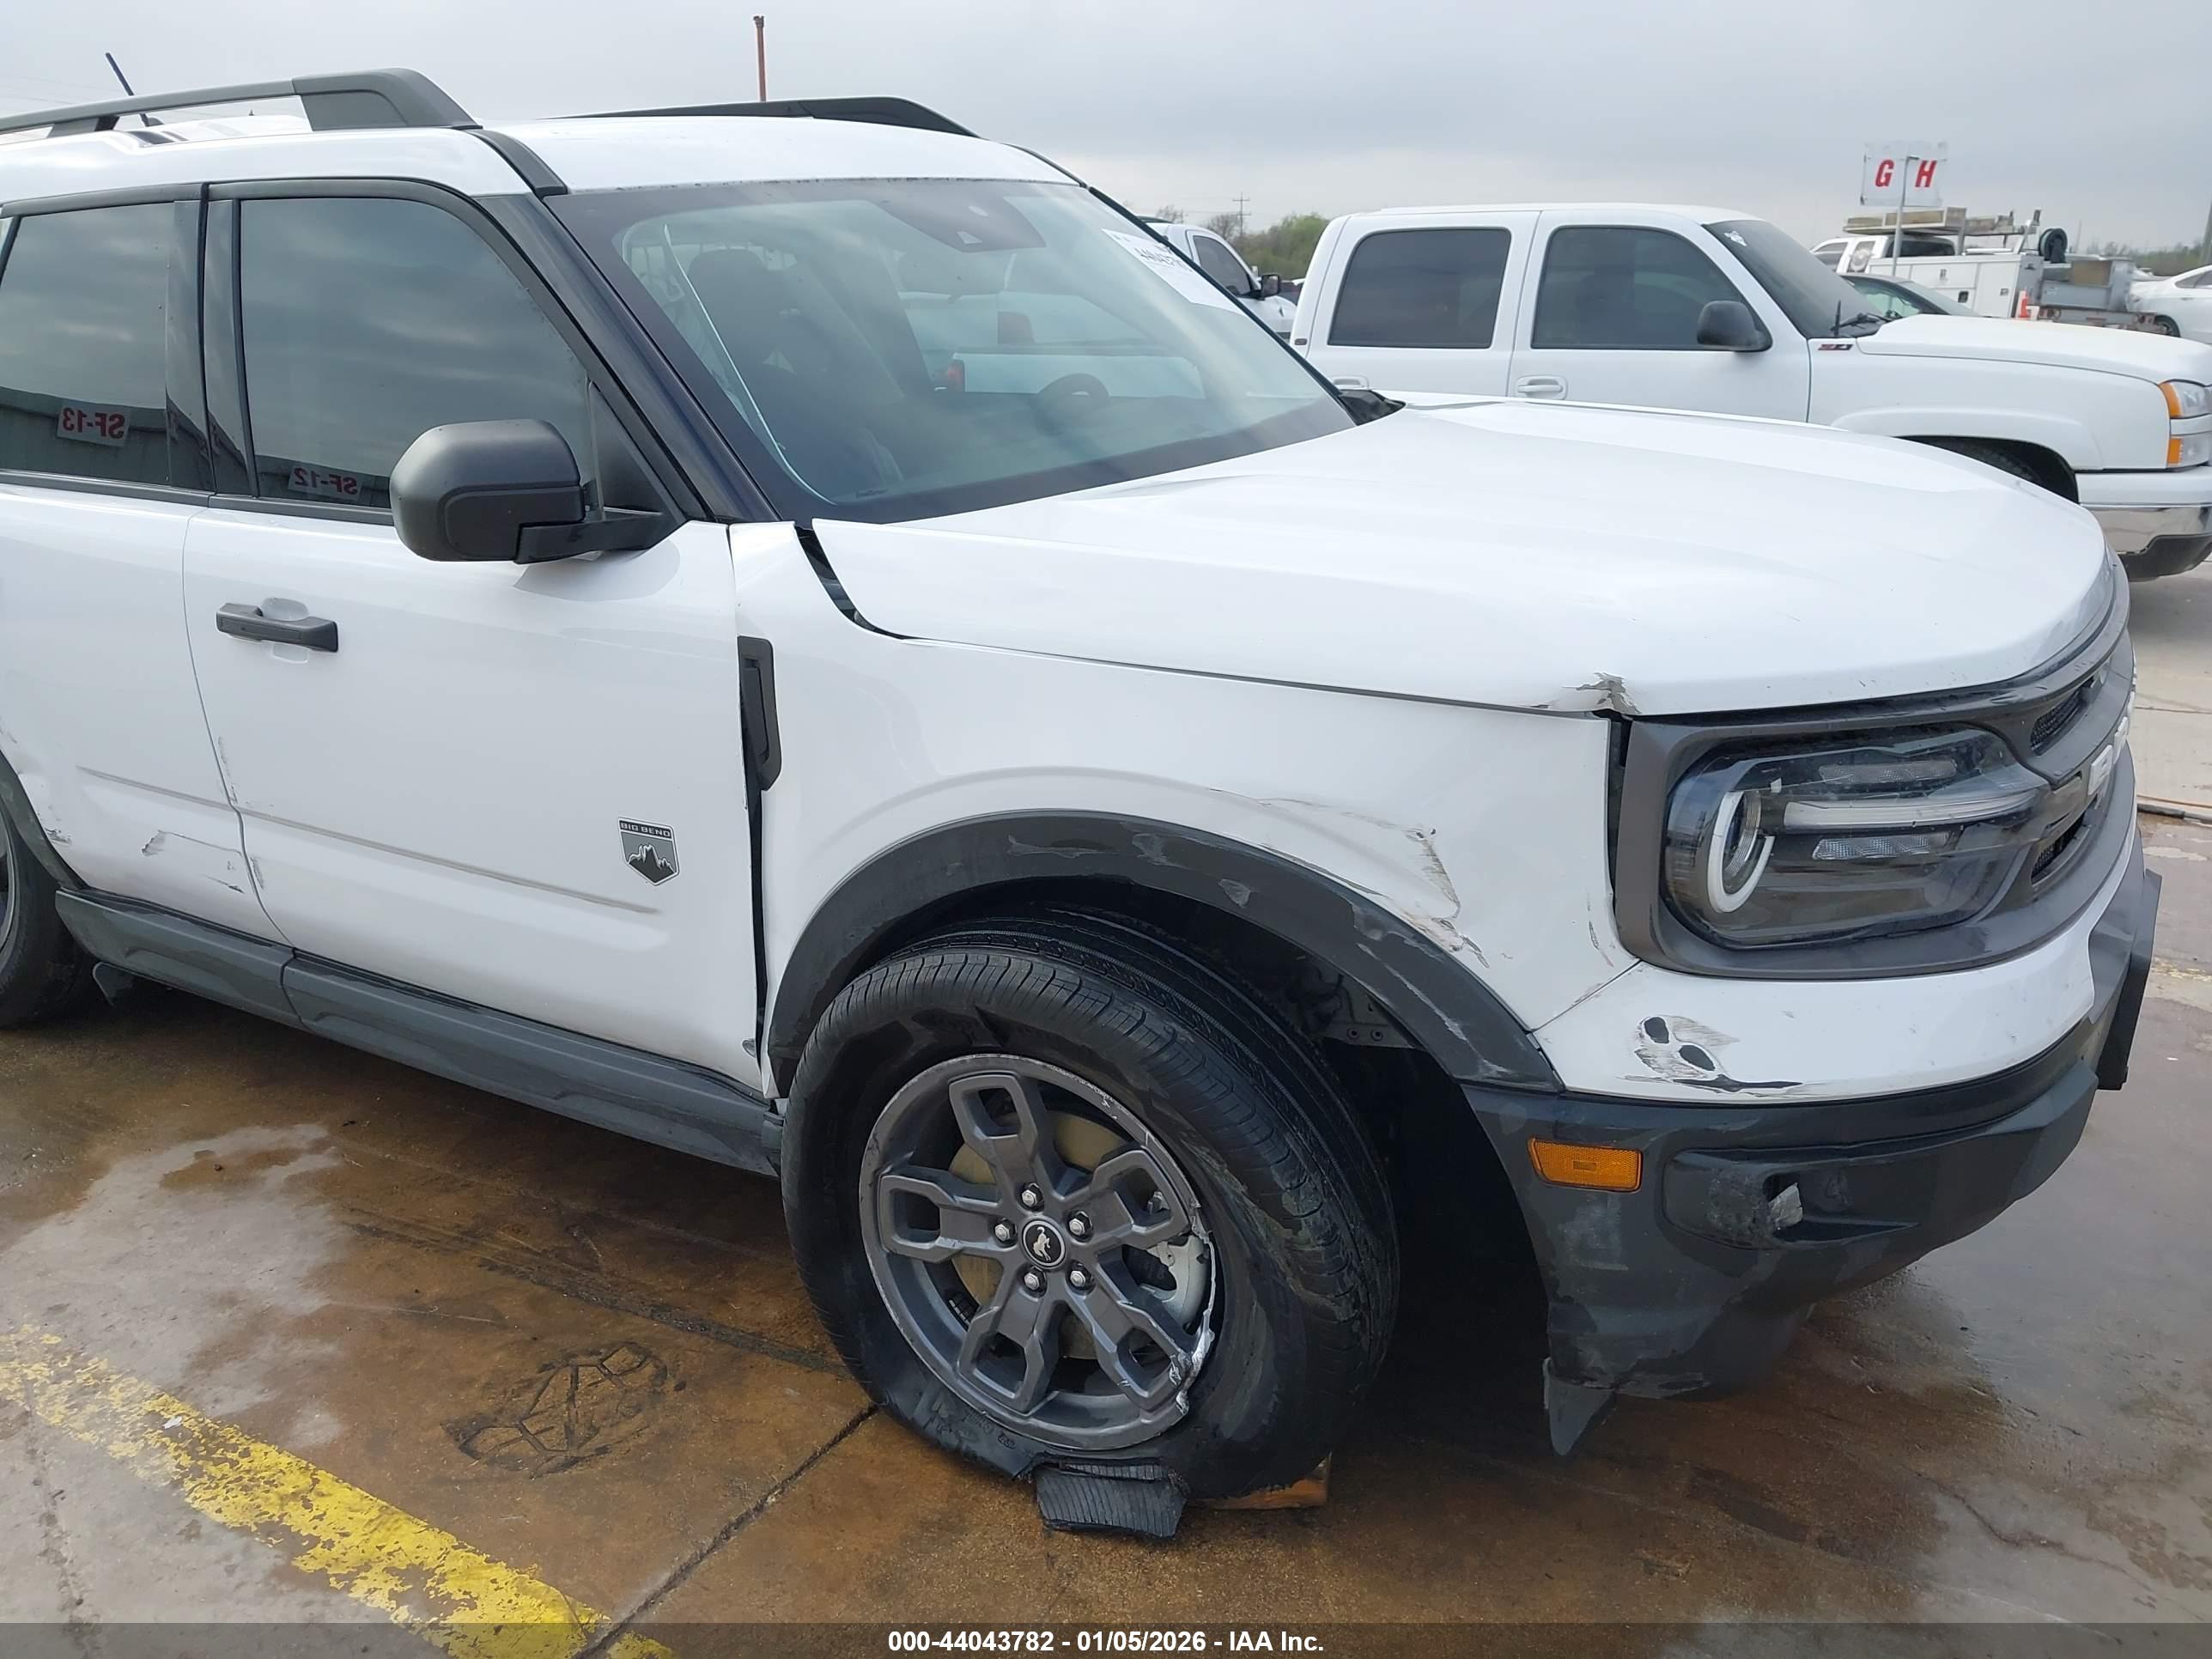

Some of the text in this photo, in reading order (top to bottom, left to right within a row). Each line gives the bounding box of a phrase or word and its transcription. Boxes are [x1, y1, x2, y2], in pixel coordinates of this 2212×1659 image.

[1875, 159, 1937, 187] G H
[620, 821, 671, 837] BIG BEND
